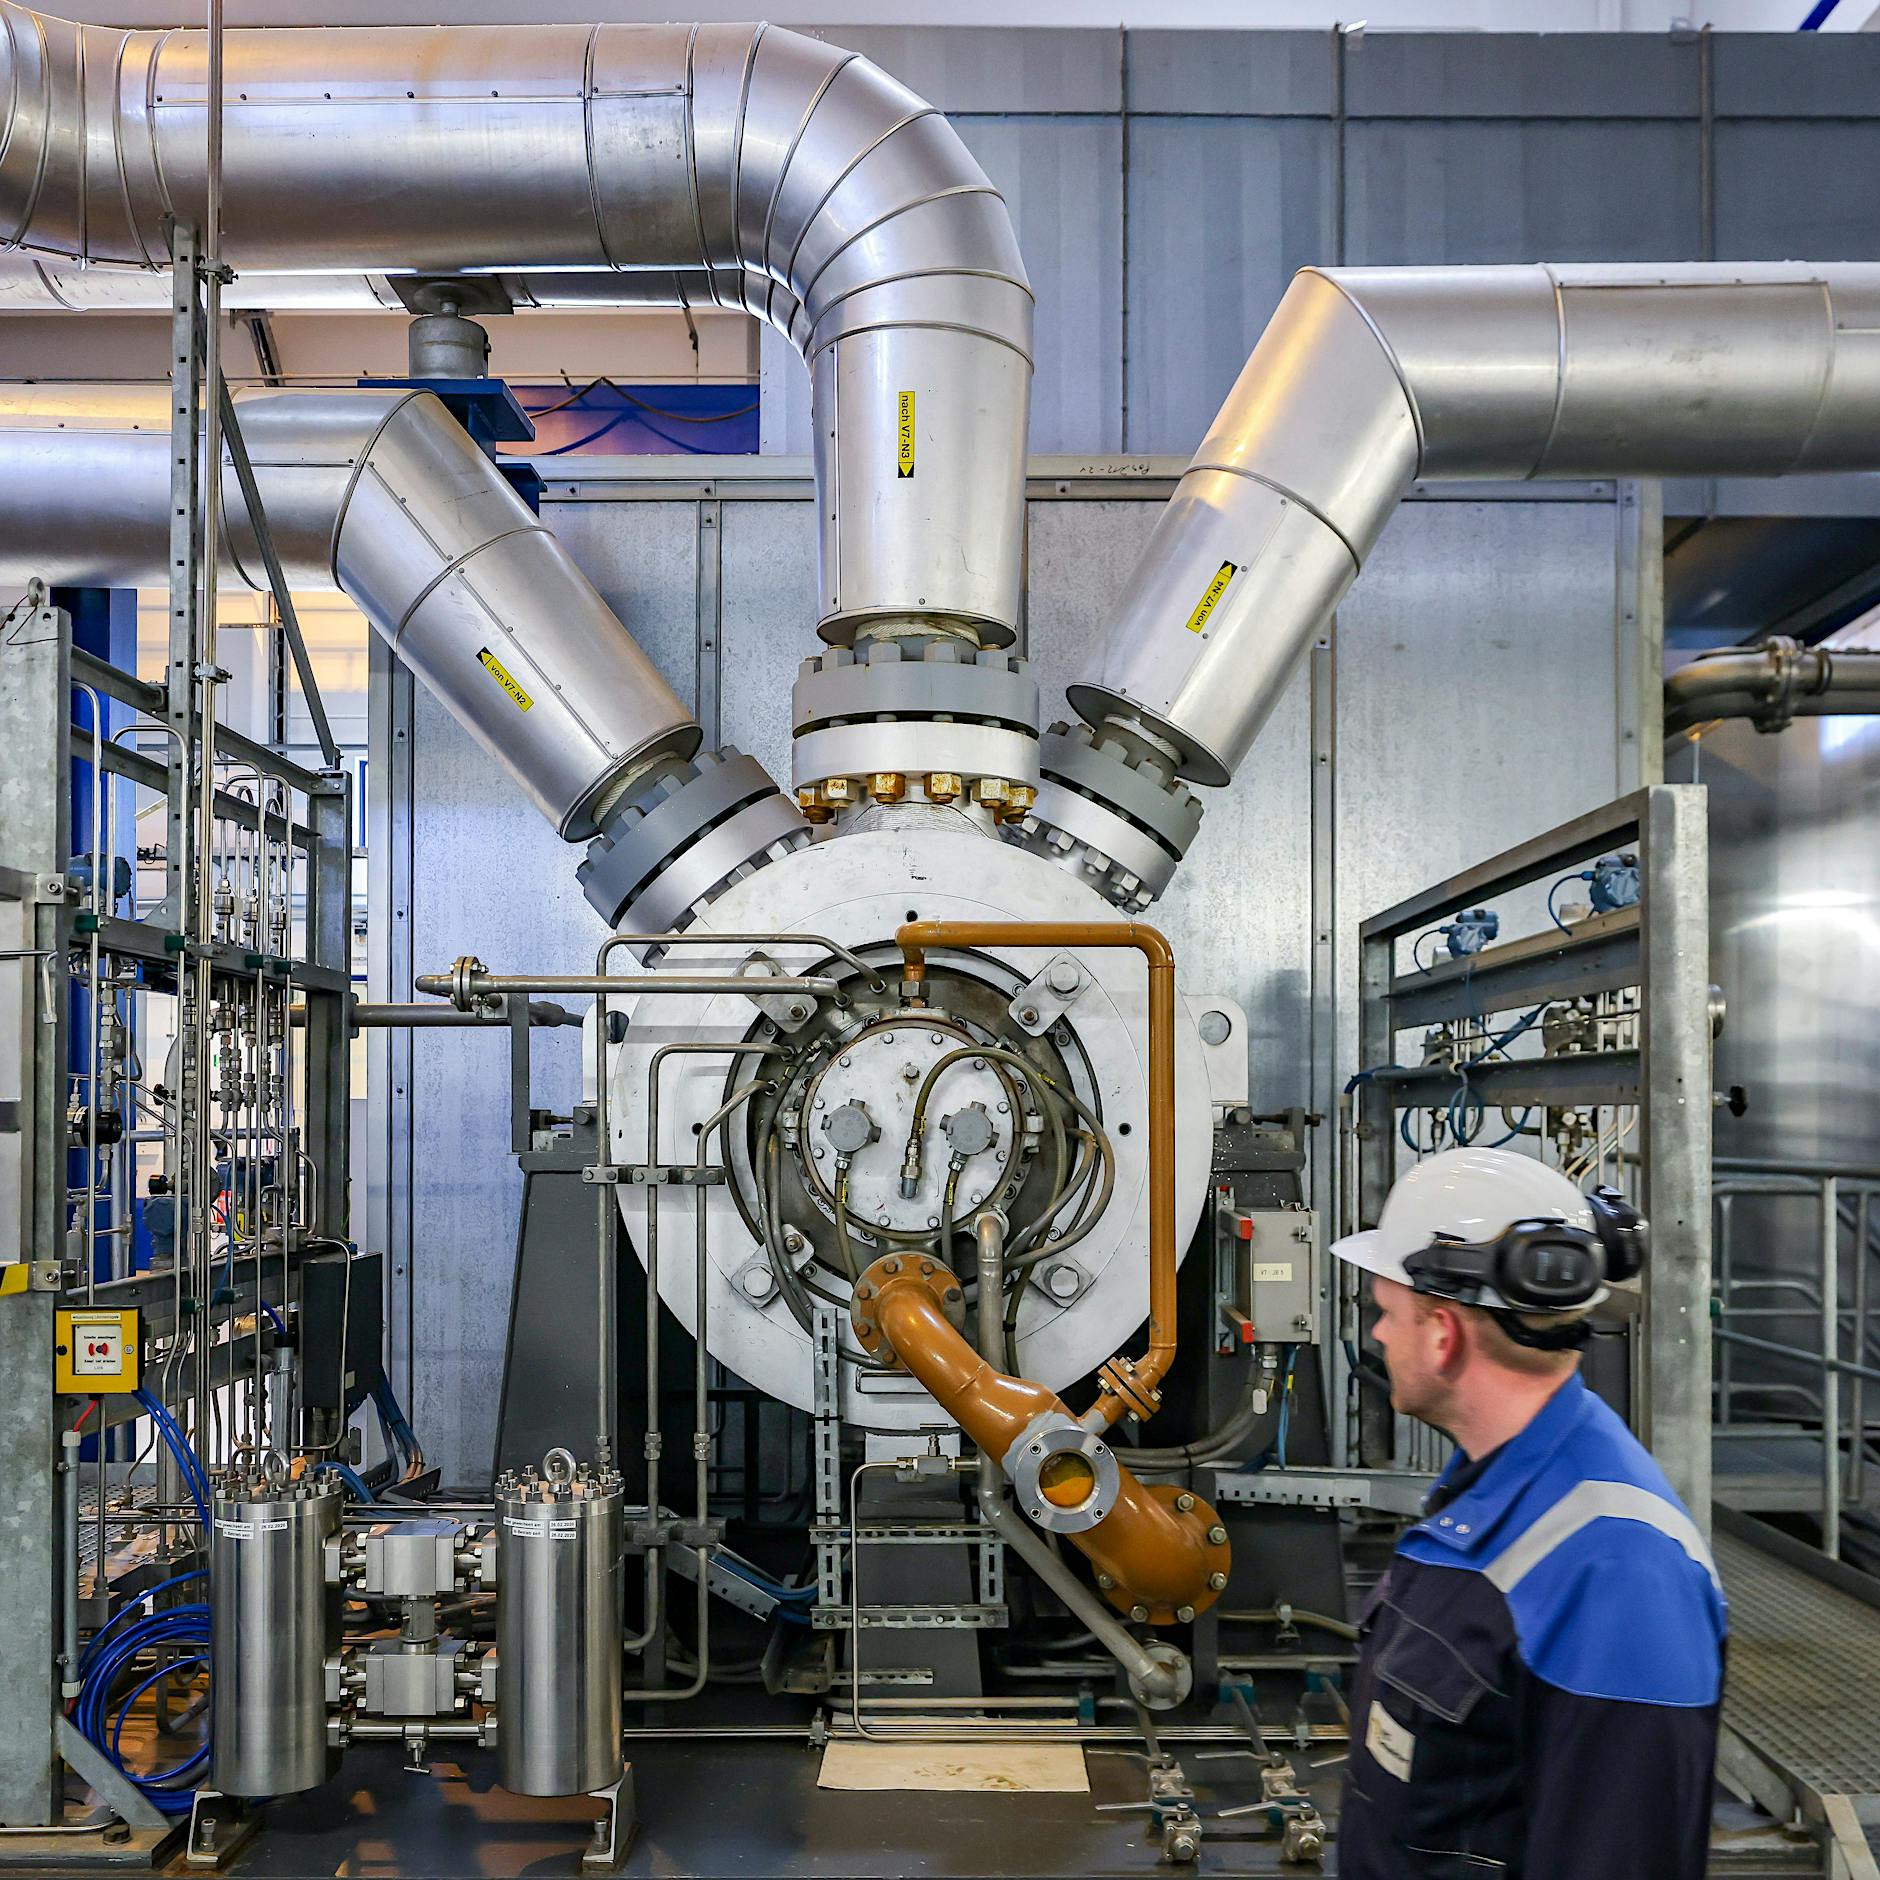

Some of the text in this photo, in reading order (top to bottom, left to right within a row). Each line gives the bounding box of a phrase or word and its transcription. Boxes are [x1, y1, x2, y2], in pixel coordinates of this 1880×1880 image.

[901, 395, 910, 459] nach V7-N3
[1194, 581, 1224, 626] von V7-N4
[491, 665, 526, 705] von V7-N2
